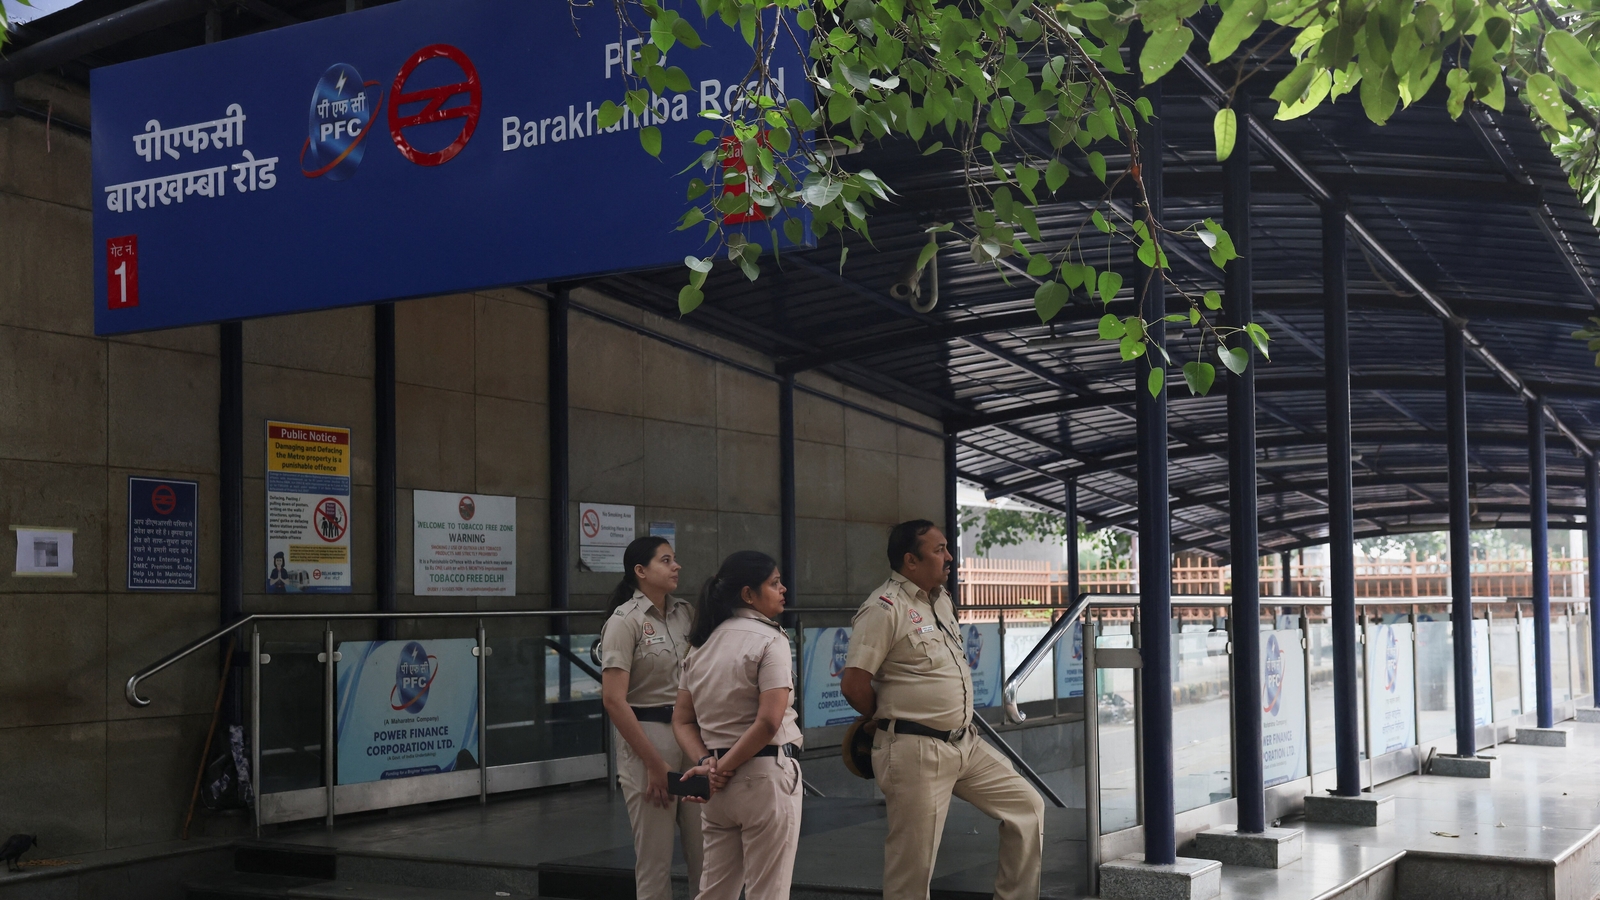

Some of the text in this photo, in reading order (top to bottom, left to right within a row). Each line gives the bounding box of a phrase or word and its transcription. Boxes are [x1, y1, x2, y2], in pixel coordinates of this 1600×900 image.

[605, 37, 667, 79] PF
[317, 92, 366, 119] पी एफ सी
[133, 103, 246, 162] पीएफसी
[321, 118, 362, 142] PFC
[105, 150, 279, 213] बाराखम्बा रोड
[110, 243, 123, 257] गेट
[114, 261, 127, 303] 1
[281, 428, 337, 443] Public Notice
[276, 442, 304, 453] Damaging
[318, 446, 342, 456] Defacing
[306, 456, 332, 464] property
[417, 521, 446, 530] WELCOME
[449, 533, 486, 544] WARNING
[430, 574, 466, 582] TOBACCO
[402, 676, 426, 688] PFC
[1268, 674, 1280, 688] PFC
[822, 690, 838, 699] POWER
[391, 716, 414, 724] Maharatna
[416, 716, 440, 724] Company)
[374, 726, 448, 742] POWER FINANCE
[1273, 730, 1292, 744] FINANCE
[366, 738, 455, 756] CORPORATION LTD.
[1264, 747, 1286, 762] ORATION
